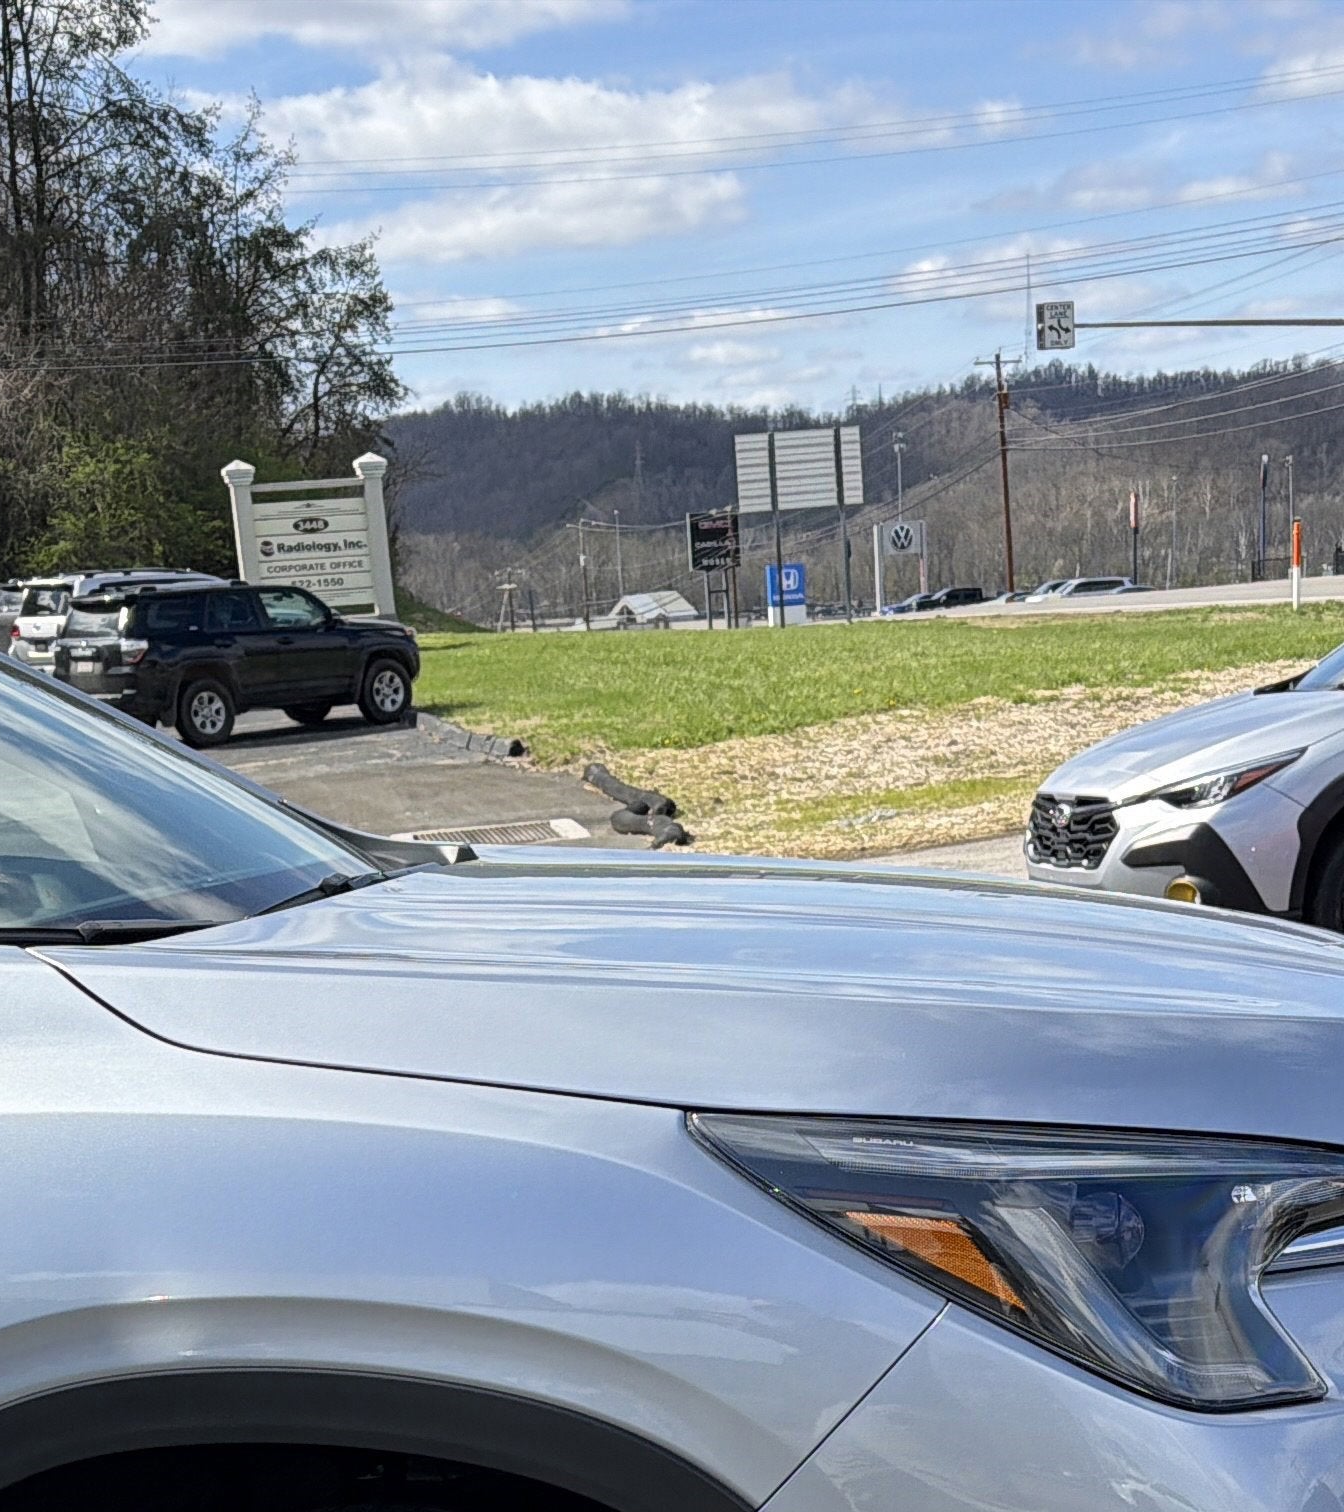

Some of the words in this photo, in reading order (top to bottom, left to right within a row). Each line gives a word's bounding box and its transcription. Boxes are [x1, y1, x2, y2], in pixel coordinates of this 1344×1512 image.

[276, 541, 343, 553] Radiology,
[343, 539, 368, 550] Inc.
[266, 562, 327, 574] CORPORATE
[329, 560, 364, 570] OFFICE
[852, 1136, 914, 1147] SUBARU
